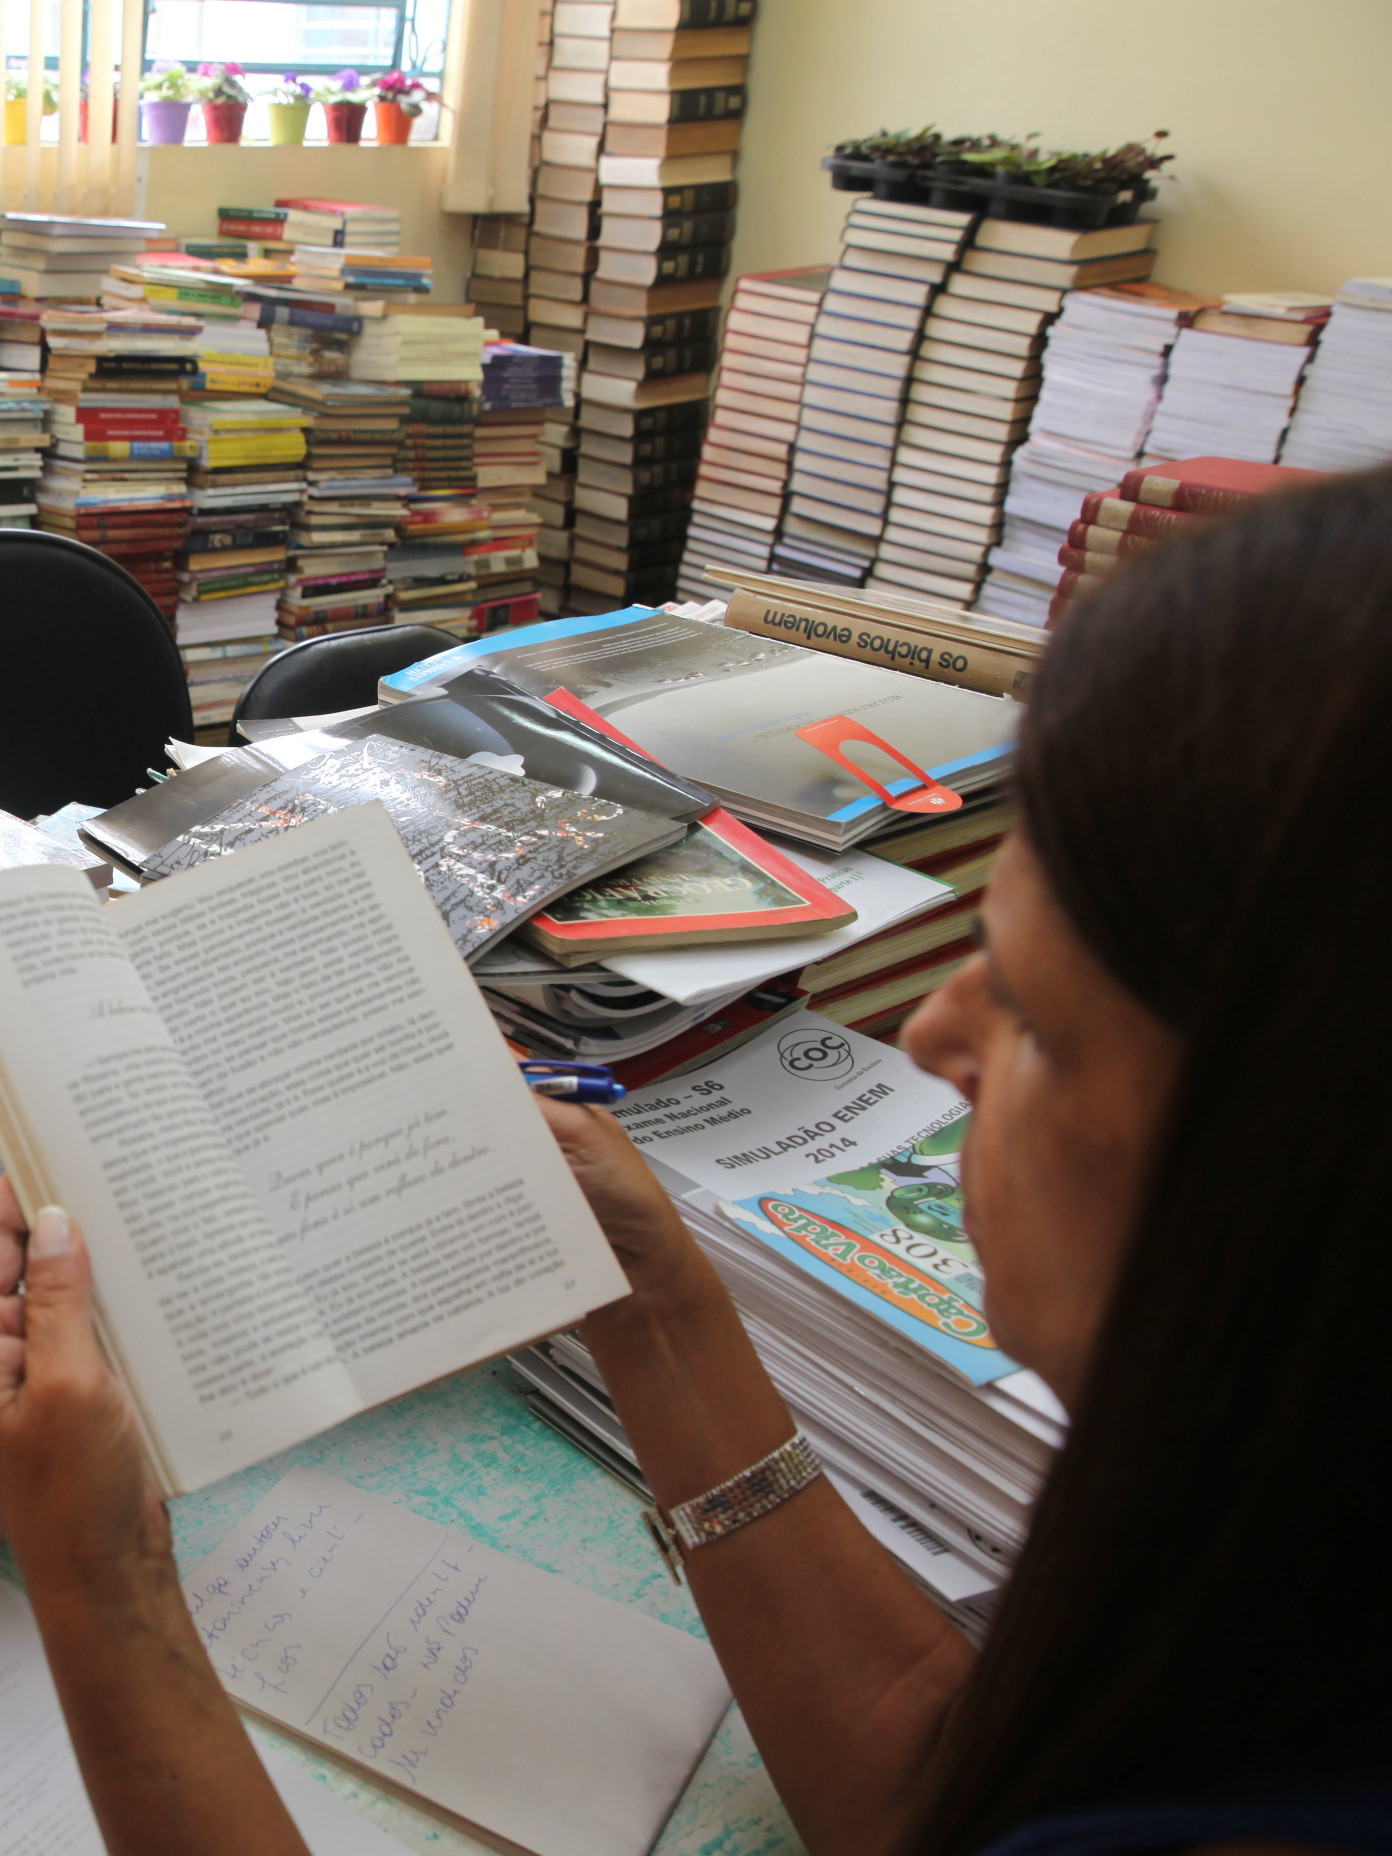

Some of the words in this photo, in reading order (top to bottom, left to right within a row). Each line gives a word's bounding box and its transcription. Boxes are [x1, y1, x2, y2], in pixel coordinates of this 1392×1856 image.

[763, 608, 853, 645] evoluem
[856, 631, 934, 670] bichos
[938, 651, 969, 673] os
[787, 1035, 846, 1073] COC
[611, 1094, 682, 1120] mulado
[691, 1079, 726, 1098] S6
[623, 1115, 665, 1134] xame
[667, 1096, 734, 1123] Nacional
[655, 1120, 706, 1142] Ensino
[707, 1105, 753, 1130] Médio
[714, 1119, 838, 1171] SIMULADÃO
[834, 1081, 896, 1126] ENEM
[902, 1098, 973, 1148] TECNOLOGIA
[804, 1136, 860, 1165] 2014
[879, 1227, 971, 1276] 308
